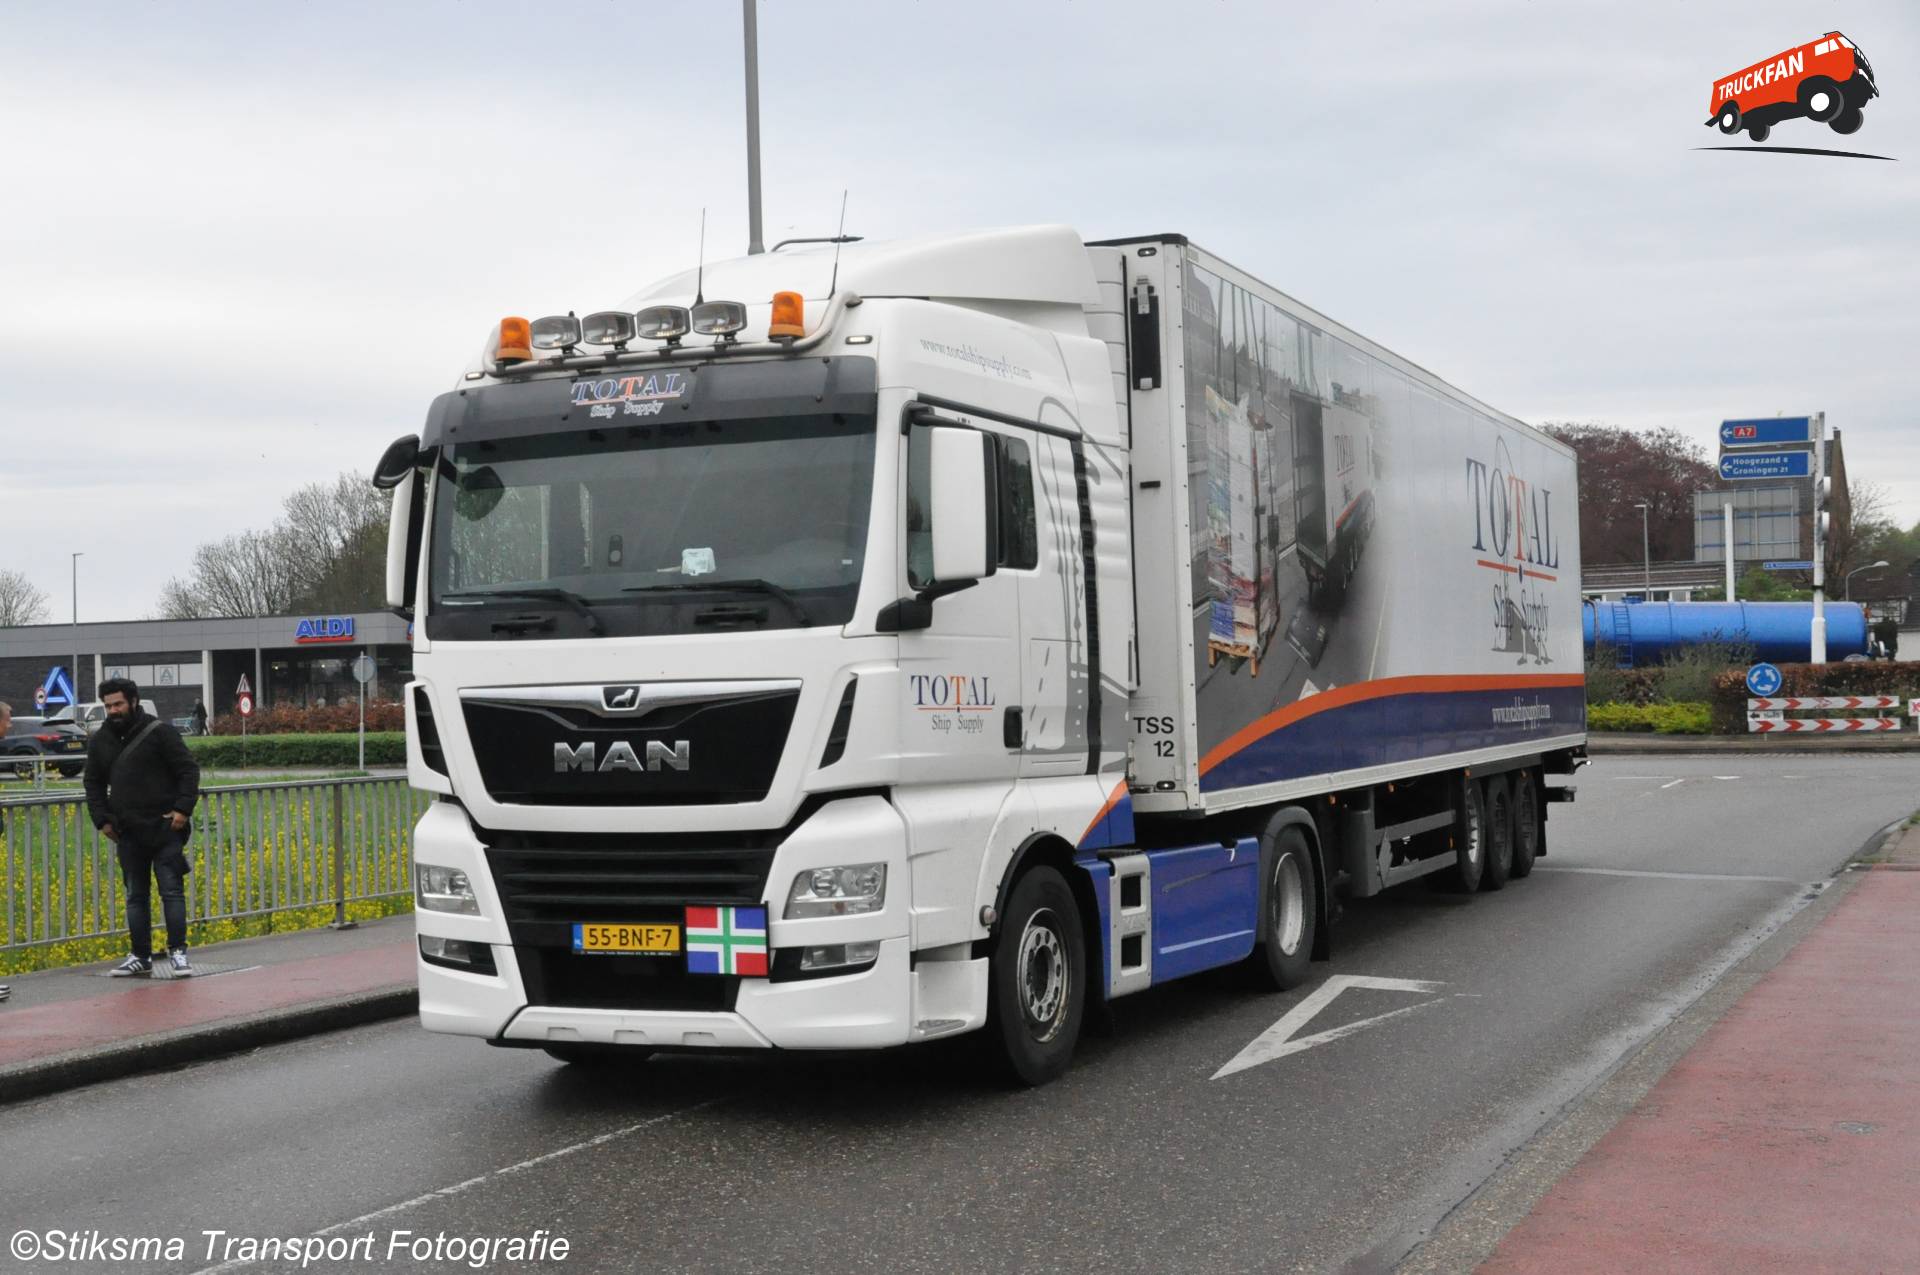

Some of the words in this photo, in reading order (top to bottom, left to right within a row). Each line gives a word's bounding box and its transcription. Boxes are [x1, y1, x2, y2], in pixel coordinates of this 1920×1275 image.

[570, 373, 686, 403] TOTAL
[590, 404, 616, 419] Ship
[624, 400, 664, 416] Supply
[1737, 427, 1752, 436] A7
[1732, 457, 1780, 466] Hoogezand
[1732, 467, 1778, 475] Groningen
[1466, 458, 1559, 569] TOTAL
[295, 616, 354, 637] ALDI
[911, 674, 996, 706] TOTAL
[932, 714, 952, 734] Ship
[958, 714, 985, 733] Supply
[1133, 716, 1175, 734] TSS
[554, 740, 690, 772] MAN
[1153, 740, 1175, 757] 12
[589, 928, 672, 947] 55-BNF-7
